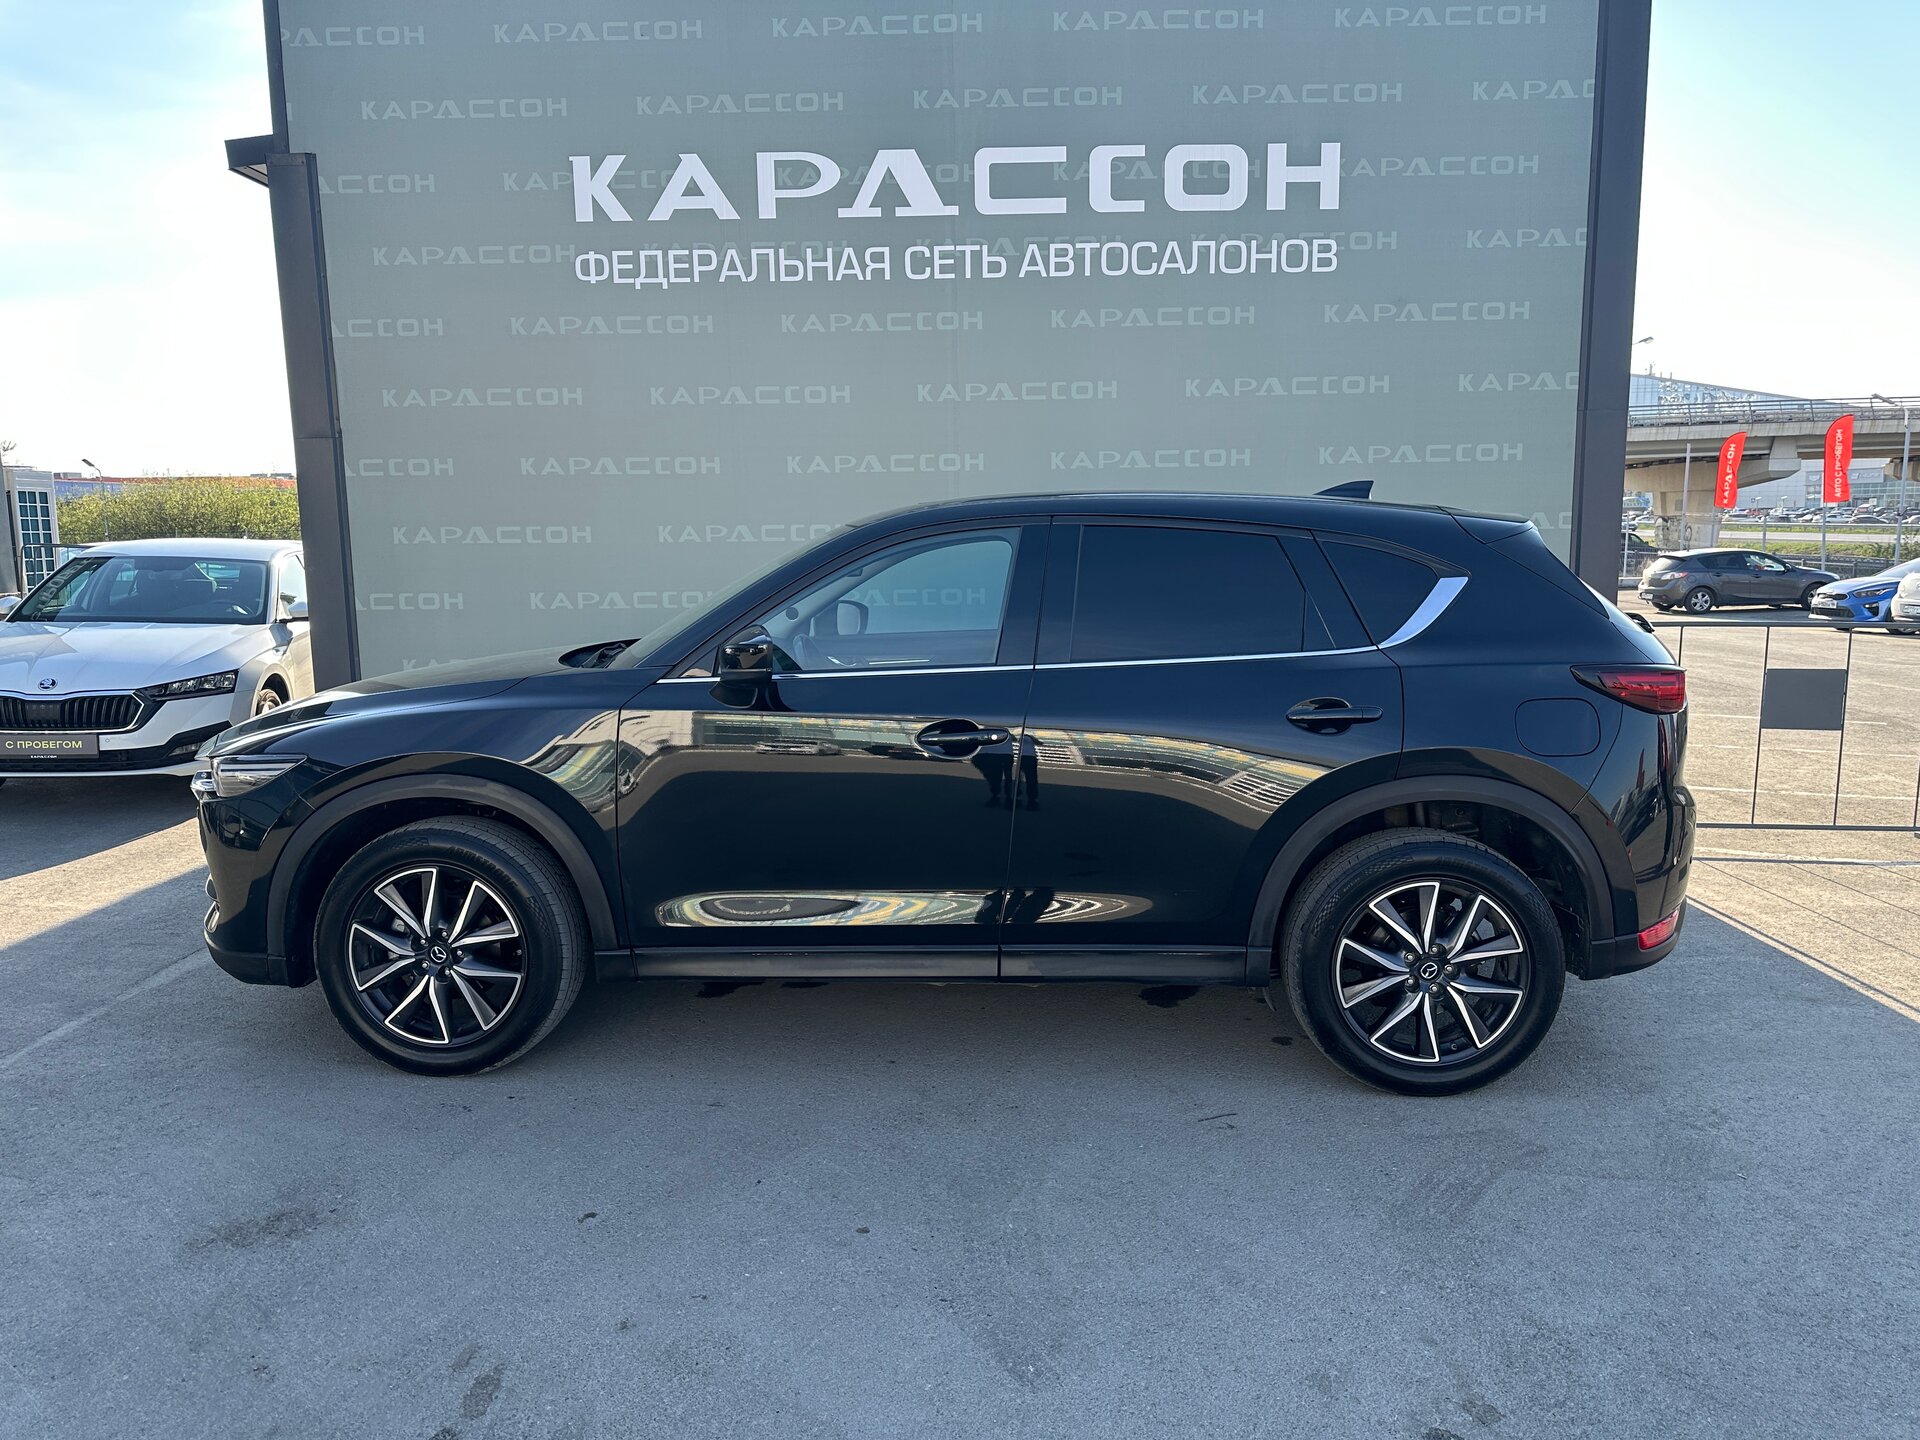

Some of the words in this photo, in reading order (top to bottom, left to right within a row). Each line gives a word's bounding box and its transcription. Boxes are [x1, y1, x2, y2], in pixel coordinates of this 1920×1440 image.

[574, 246, 890, 289] ФЕДЕРАЛЬНАЯ
[904, 243, 1008, 280] СЕТЬ
[1018, 239, 1338, 278] АВТОСАЛОНОВ
[1834, 477, 1842, 498] АВТО
[5, 741, 14, 749] С
[17, 740, 83, 749] ПРОБЕГОМ
